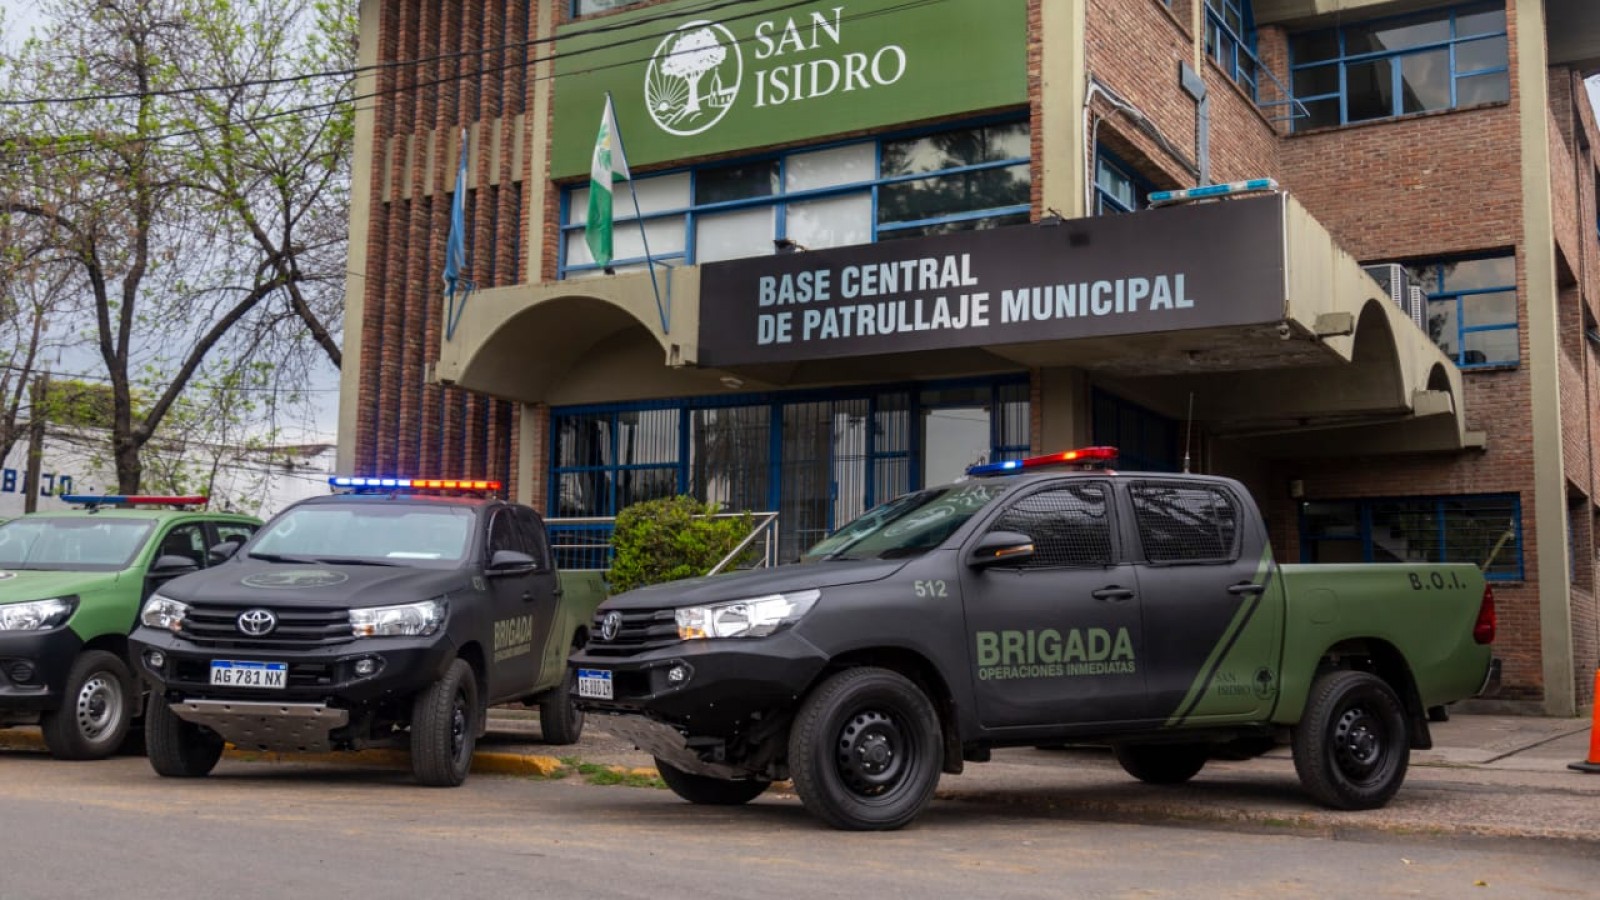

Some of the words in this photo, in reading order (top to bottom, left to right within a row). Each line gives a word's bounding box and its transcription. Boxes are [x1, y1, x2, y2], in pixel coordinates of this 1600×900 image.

[754, 7, 844, 60] SAN
[753, 45, 907, 107] ISIDRO
[759, 269, 830, 307] BASE
[840, 253, 978, 299] CENTRAL
[757, 312, 792, 345] DE
[803, 292, 990, 341] PATRULLAJE
[1000, 273, 1194, 324] MUNICIPAL
[915, 580, 948, 597] 512
[1409, 571, 1467, 591] B.O.I.
[494, 614, 533, 651] BRIGADA
[976, 627, 1135, 666] BRIGADA
[214, 669, 231, 683] AG
[235, 669, 261, 685] 781
[264, 670, 282, 686] NX
[978, 665, 1064, 681] OPERACIONES
[1066, 660, 1136, 676] INMEDIATAS
